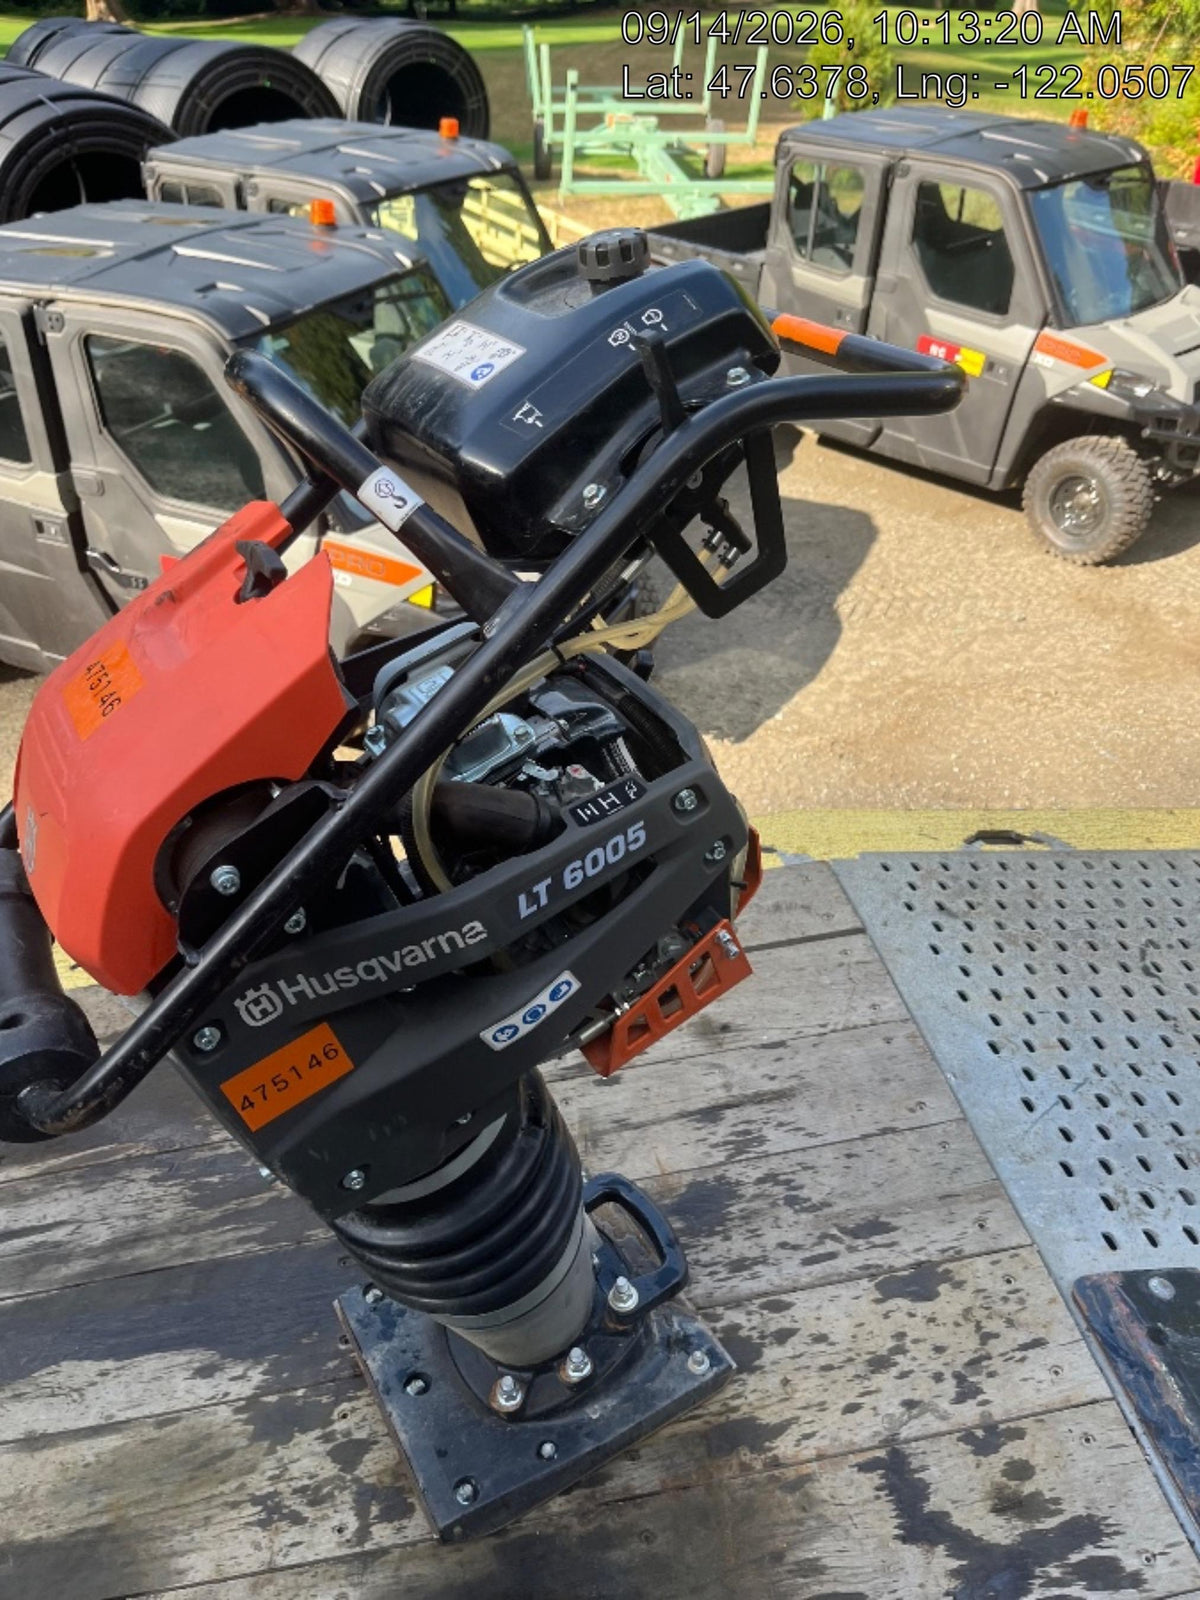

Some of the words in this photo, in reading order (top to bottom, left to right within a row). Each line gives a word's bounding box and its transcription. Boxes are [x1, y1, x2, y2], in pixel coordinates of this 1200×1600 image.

[85, 660, 122, 718] 475146
[518, 876, 552, 920] LT
[563, 820, 647, 890] 6005
[277, 920, 489, 1006] Husqvarna
[240, 1042, 340, 1113] 475146
